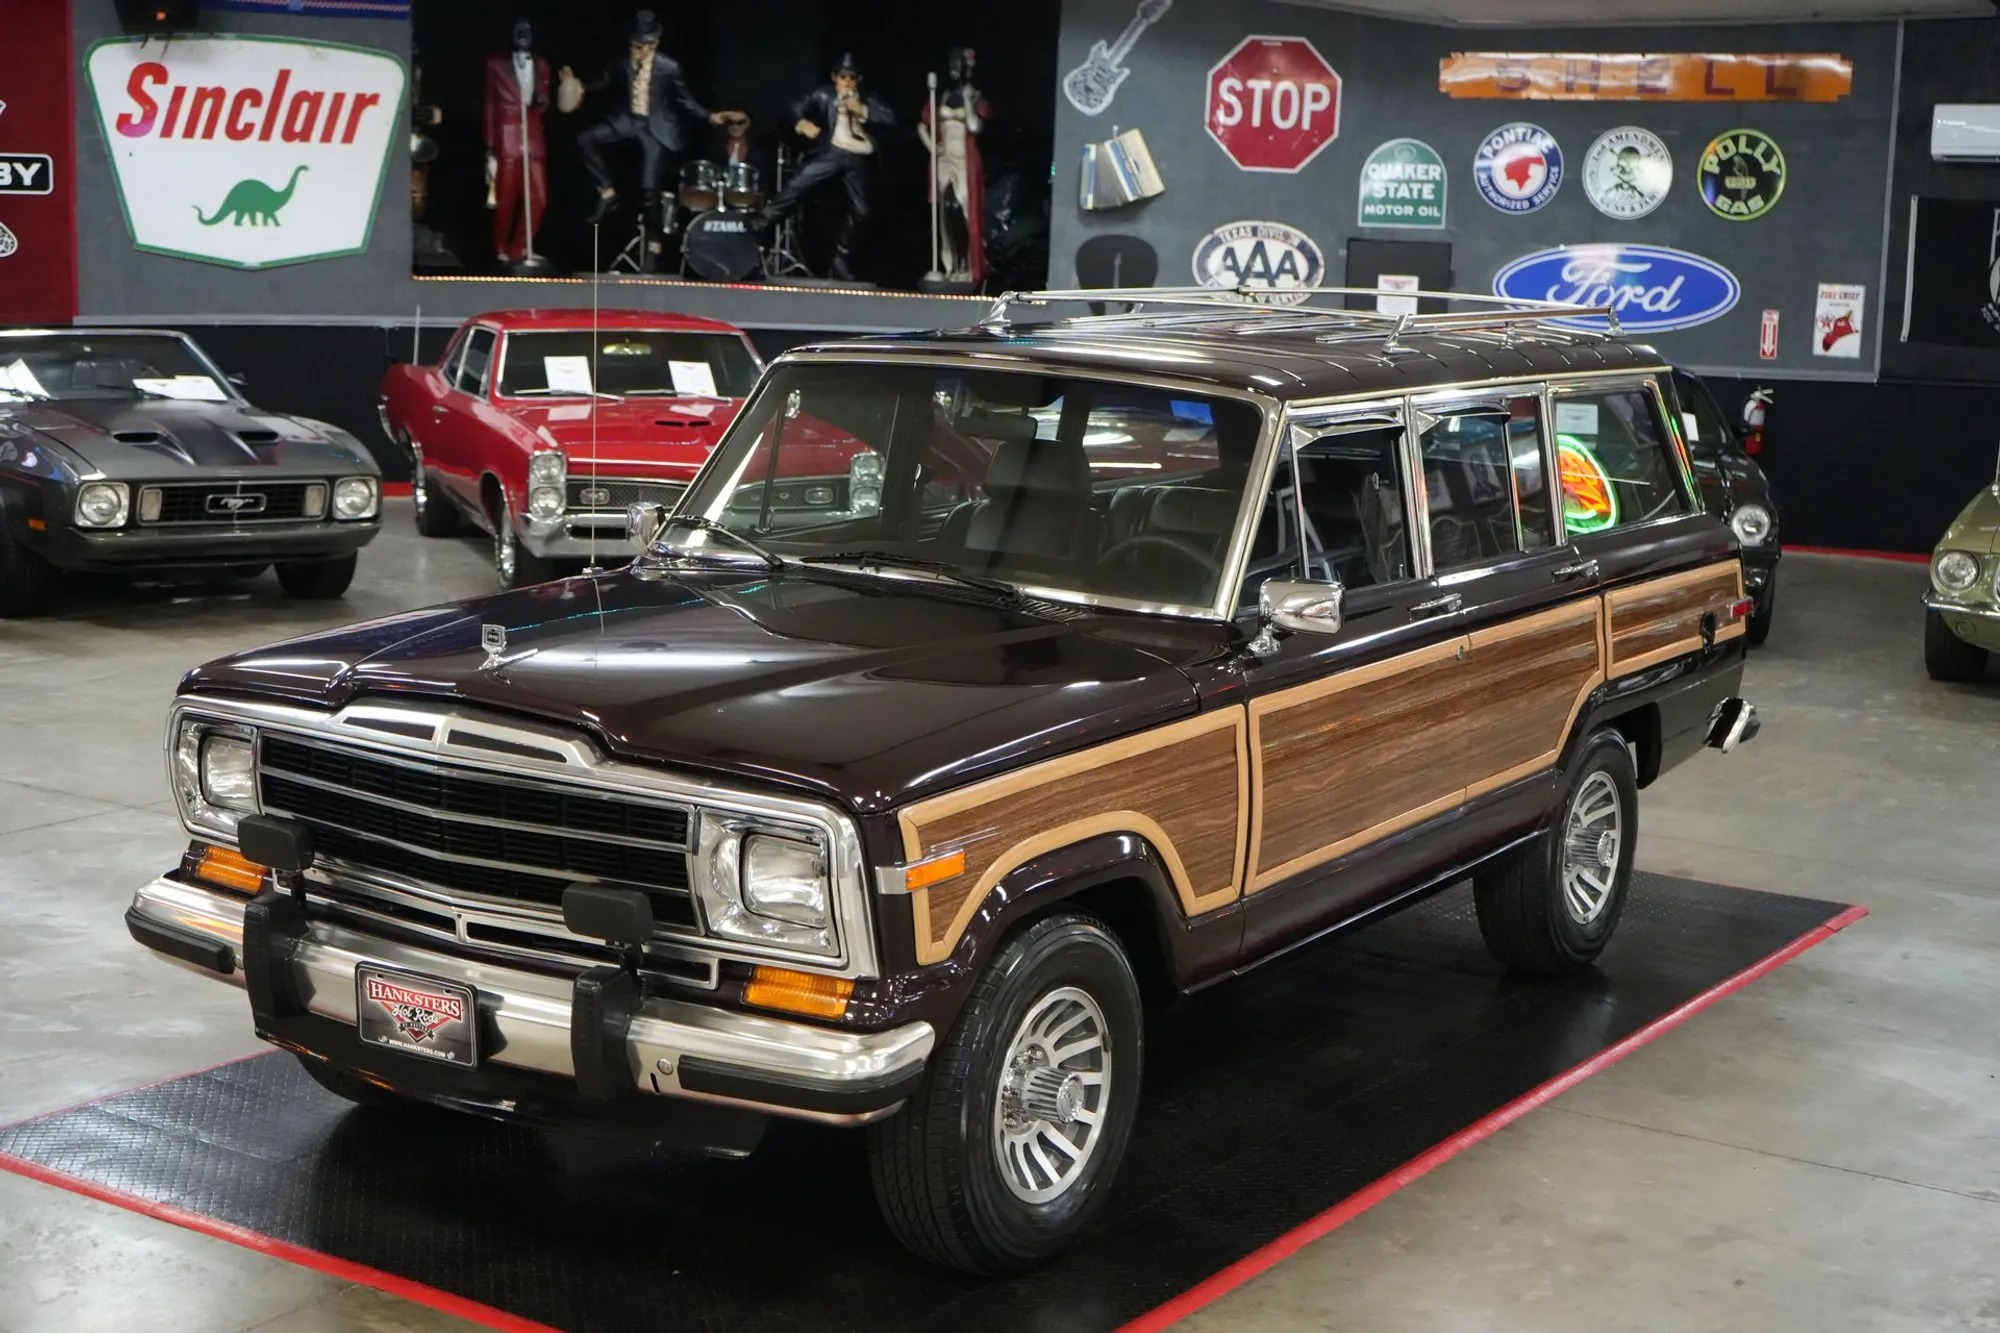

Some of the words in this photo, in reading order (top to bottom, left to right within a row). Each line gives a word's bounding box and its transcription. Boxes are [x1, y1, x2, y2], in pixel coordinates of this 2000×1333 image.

[1496, 59, 1798, 95] SHELL
[116, 61, 380, 144] Sinclair
[1215, 77, 1331, 131] STOP
[1482, 127, 1555, 159] PONTIAC
[1608, 133, 1667, 166] AMENDMEN
[1703, 134, 1781, 175] POLLY
[1367, 161, 1442, 181] QUAKER
[1478, 171, 1531, 210] AUTHORIZED
[1532, 165, 1560, 206] SERVICE
[1371, 180, 1436, 200] STATE
[1715, 193, 1765, 215] GAS
[1363, 203, 1415, 217] MOTOR
[1418, 205, 1442, 218] OIL
[1220, 226, 1253, 244] TEXAS
[1221, 240, 1299, 287] AAA
[1545, 259, 1686, 313] Ford
[370, 982, 460, 1017] HANKSTERS
[392, 1003, 413, 1017] Hot
[413, 1006, 441, 1026] Rods
